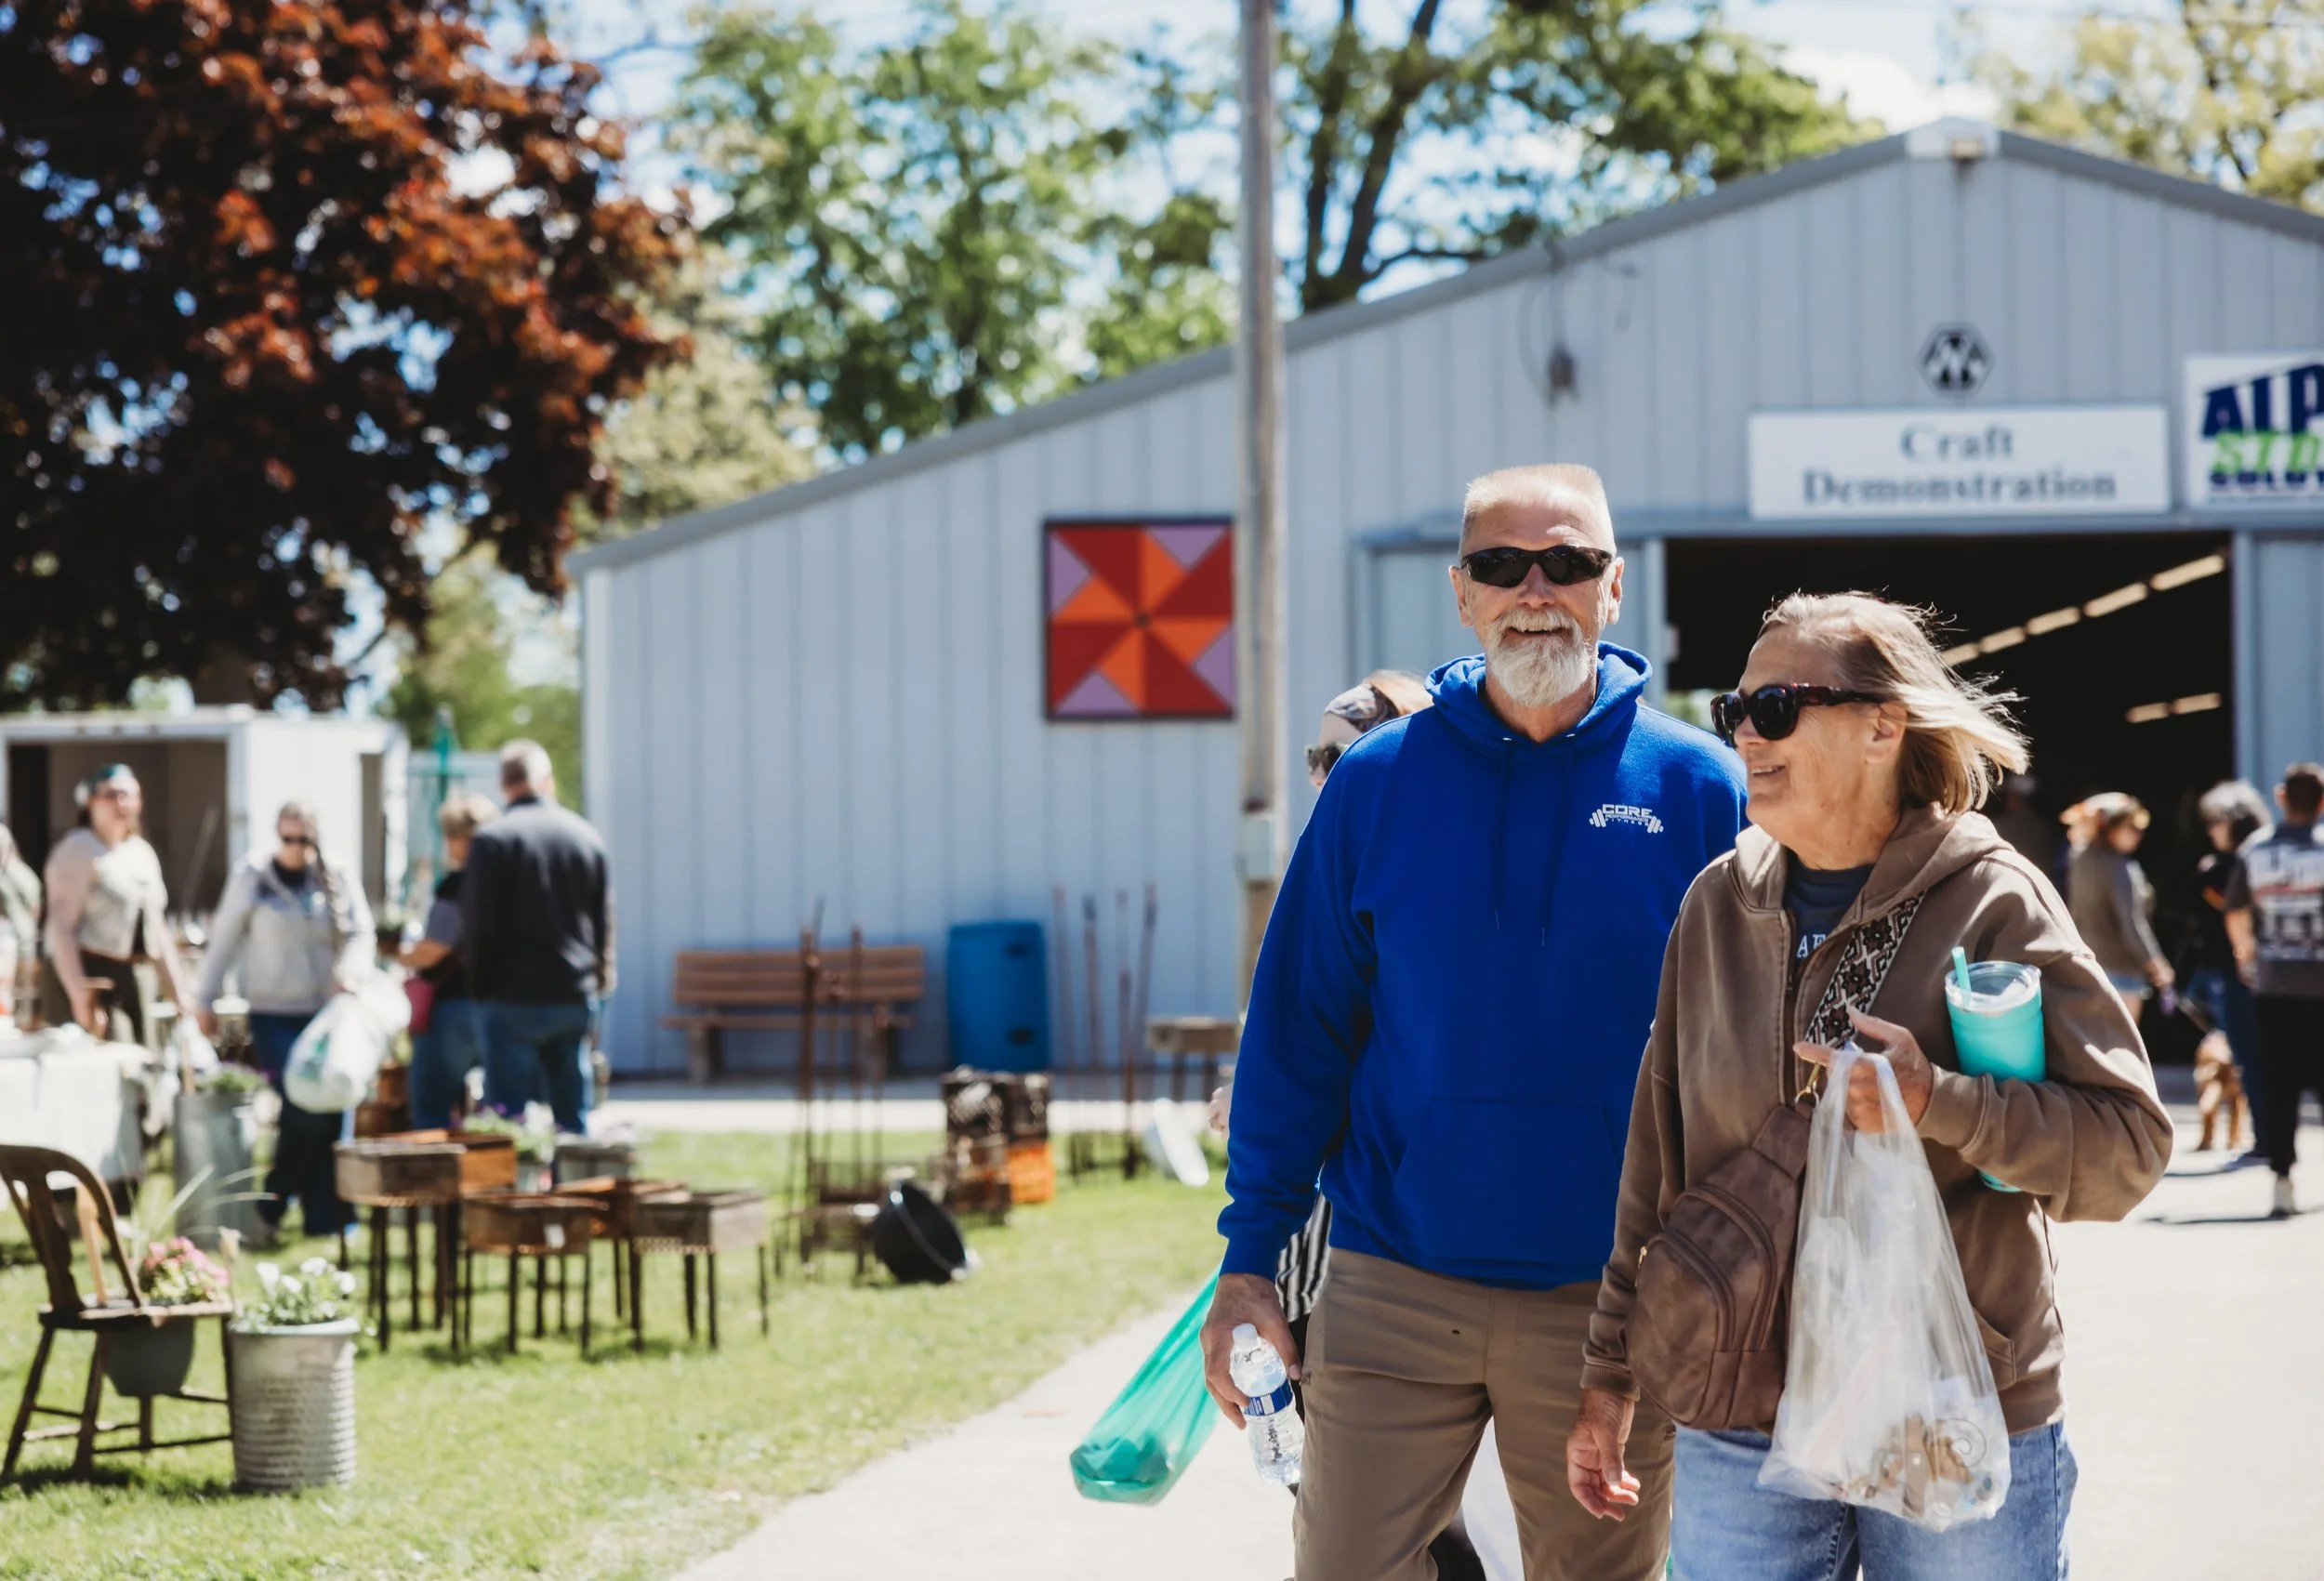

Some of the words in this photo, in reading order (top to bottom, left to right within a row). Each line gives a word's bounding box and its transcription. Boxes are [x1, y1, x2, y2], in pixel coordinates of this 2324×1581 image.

[1900, 423, 2014, 460] Craft
[1802, 464, 2117, 504] Demonstration
[1602, 804, 1653, 818] CORE
